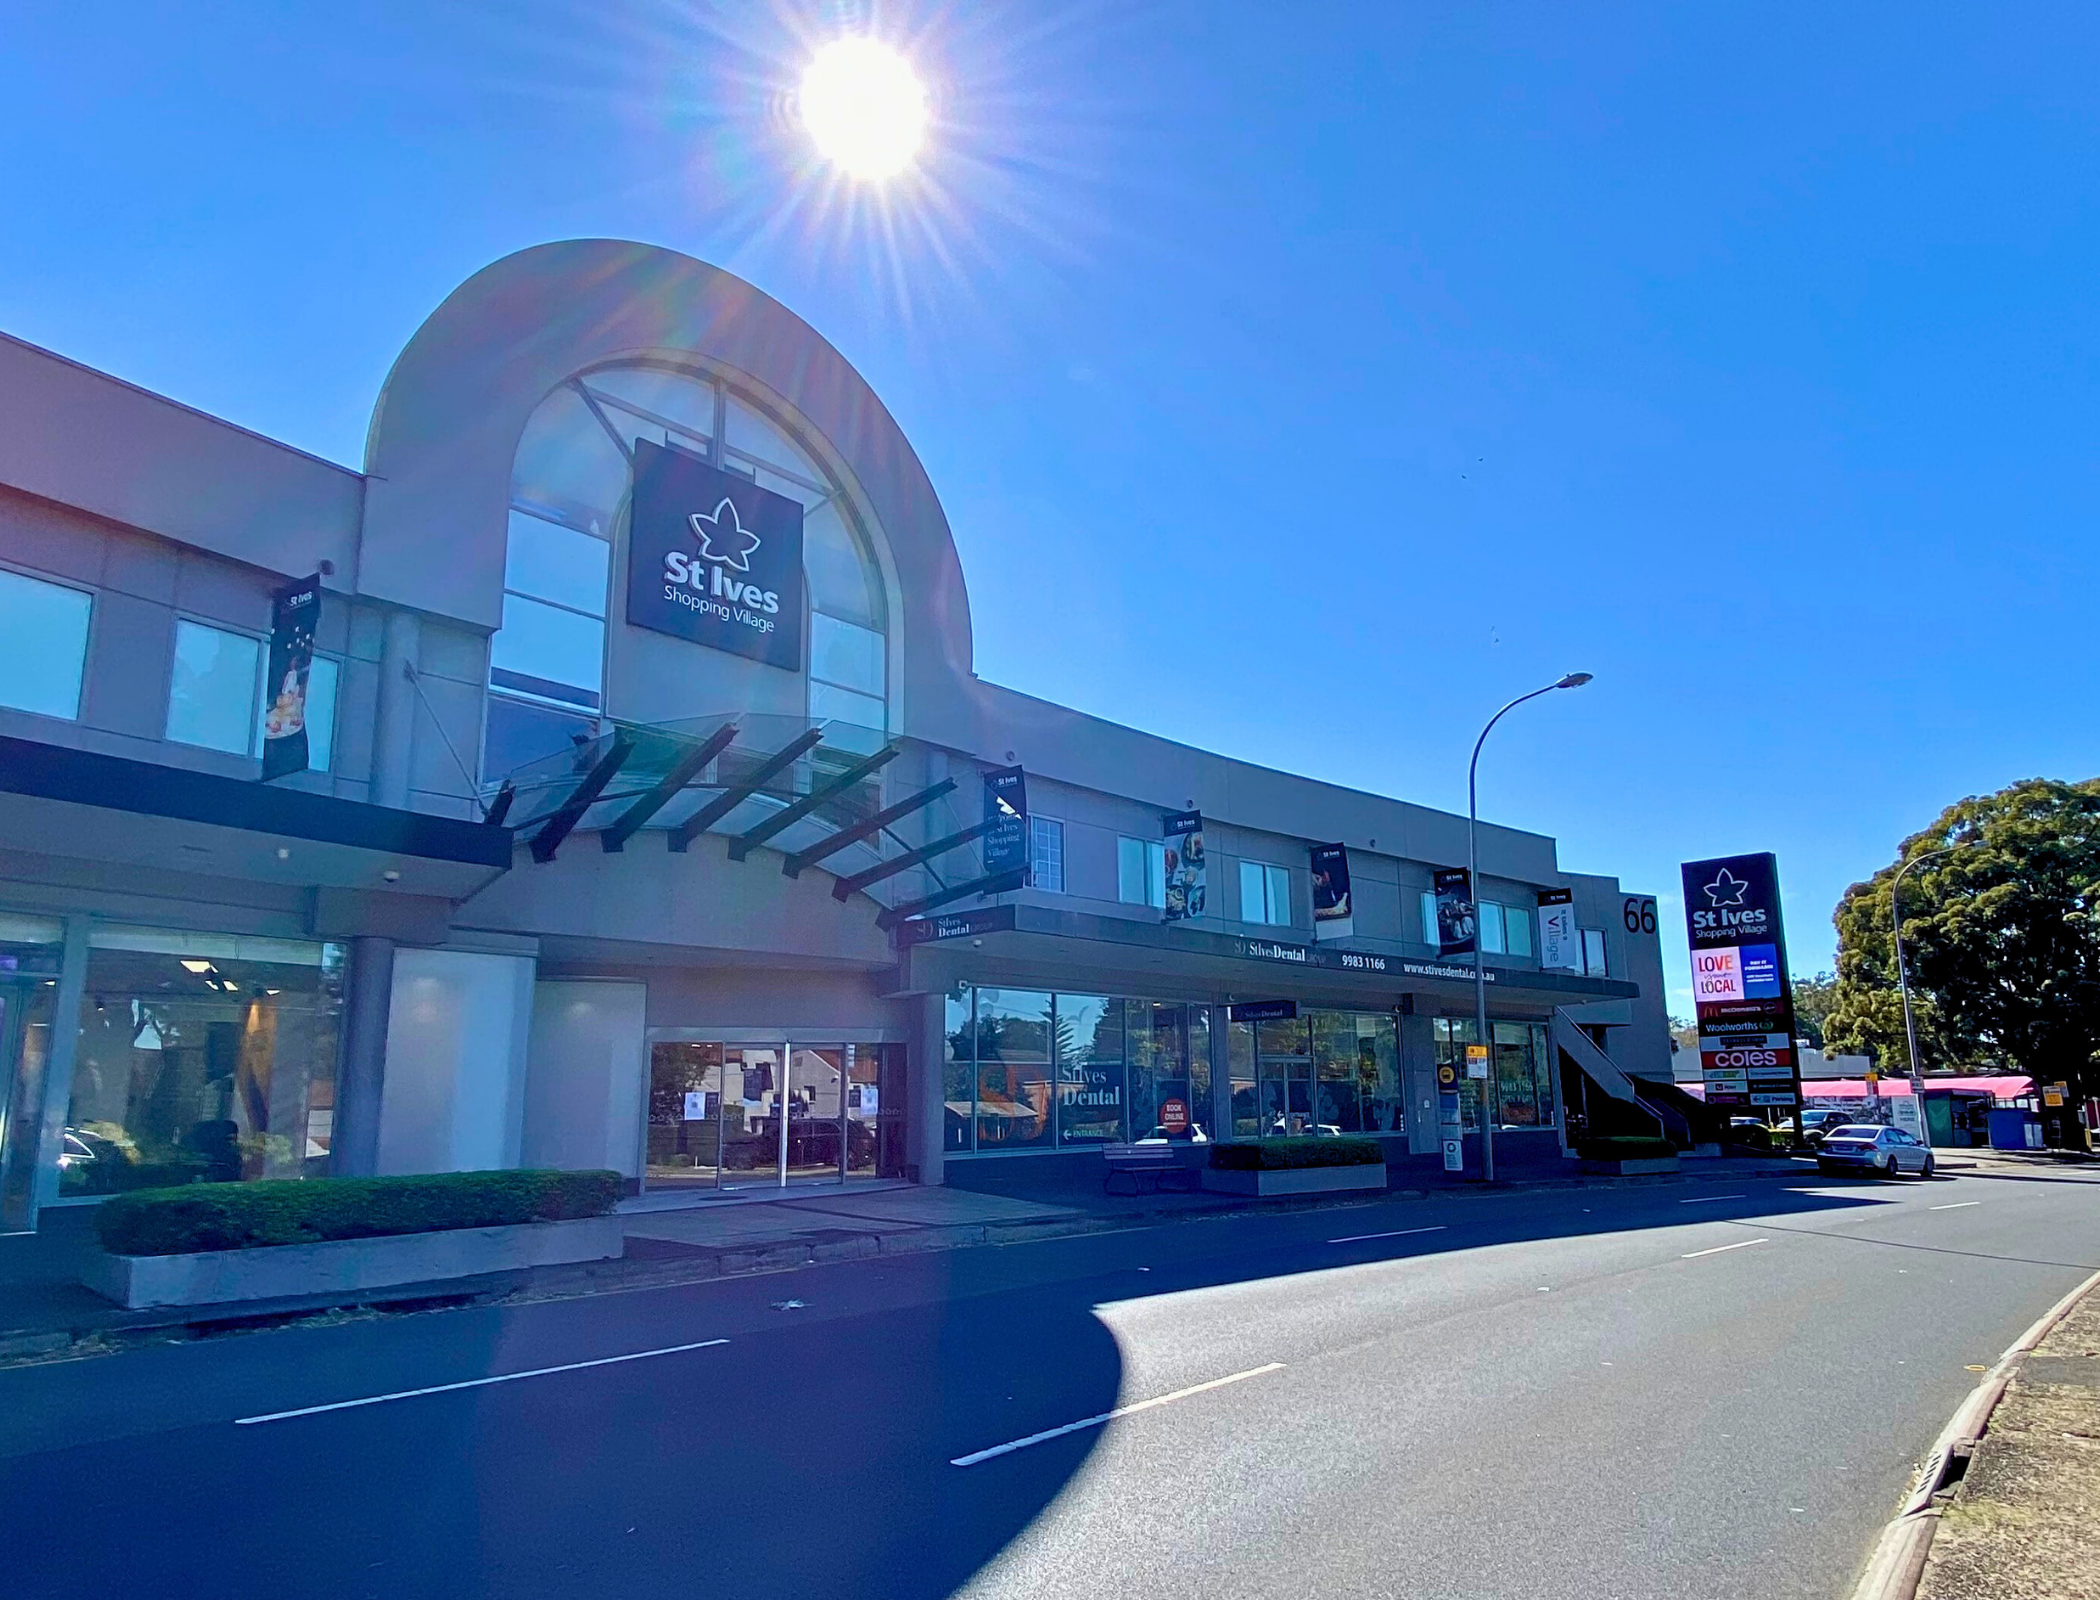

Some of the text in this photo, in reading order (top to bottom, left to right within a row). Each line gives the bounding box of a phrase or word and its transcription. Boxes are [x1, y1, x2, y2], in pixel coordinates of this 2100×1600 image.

[664, 551, 780, 614] St Ives
[664, 585, 775, 633] Shopping Village
[1005, 776, 1018, 784] Ives
[1624, 898, 1656, 934] 66
[1693, 908, 1766, 928] St Ives
[938, 923, 969, 937] Dental
[1696, 925, 1767, 939] Shopping Village
[1546, 916, 1561, 962] Village
[1341, 954, 1363, 968] 9983
[1365, 957, 1385, 970] 1166
[1698, 955, 1733, 972] LOVE
[1701, 979, 1736, 994] LOCAL
[1706, 1022, 1758, 1032] Woolworths
[1715, 1051, 1777, 1067] coles
[1063, 1086, 1120, 1106] Dental
[1165, 1112, 1184, 1121] ONLINE
